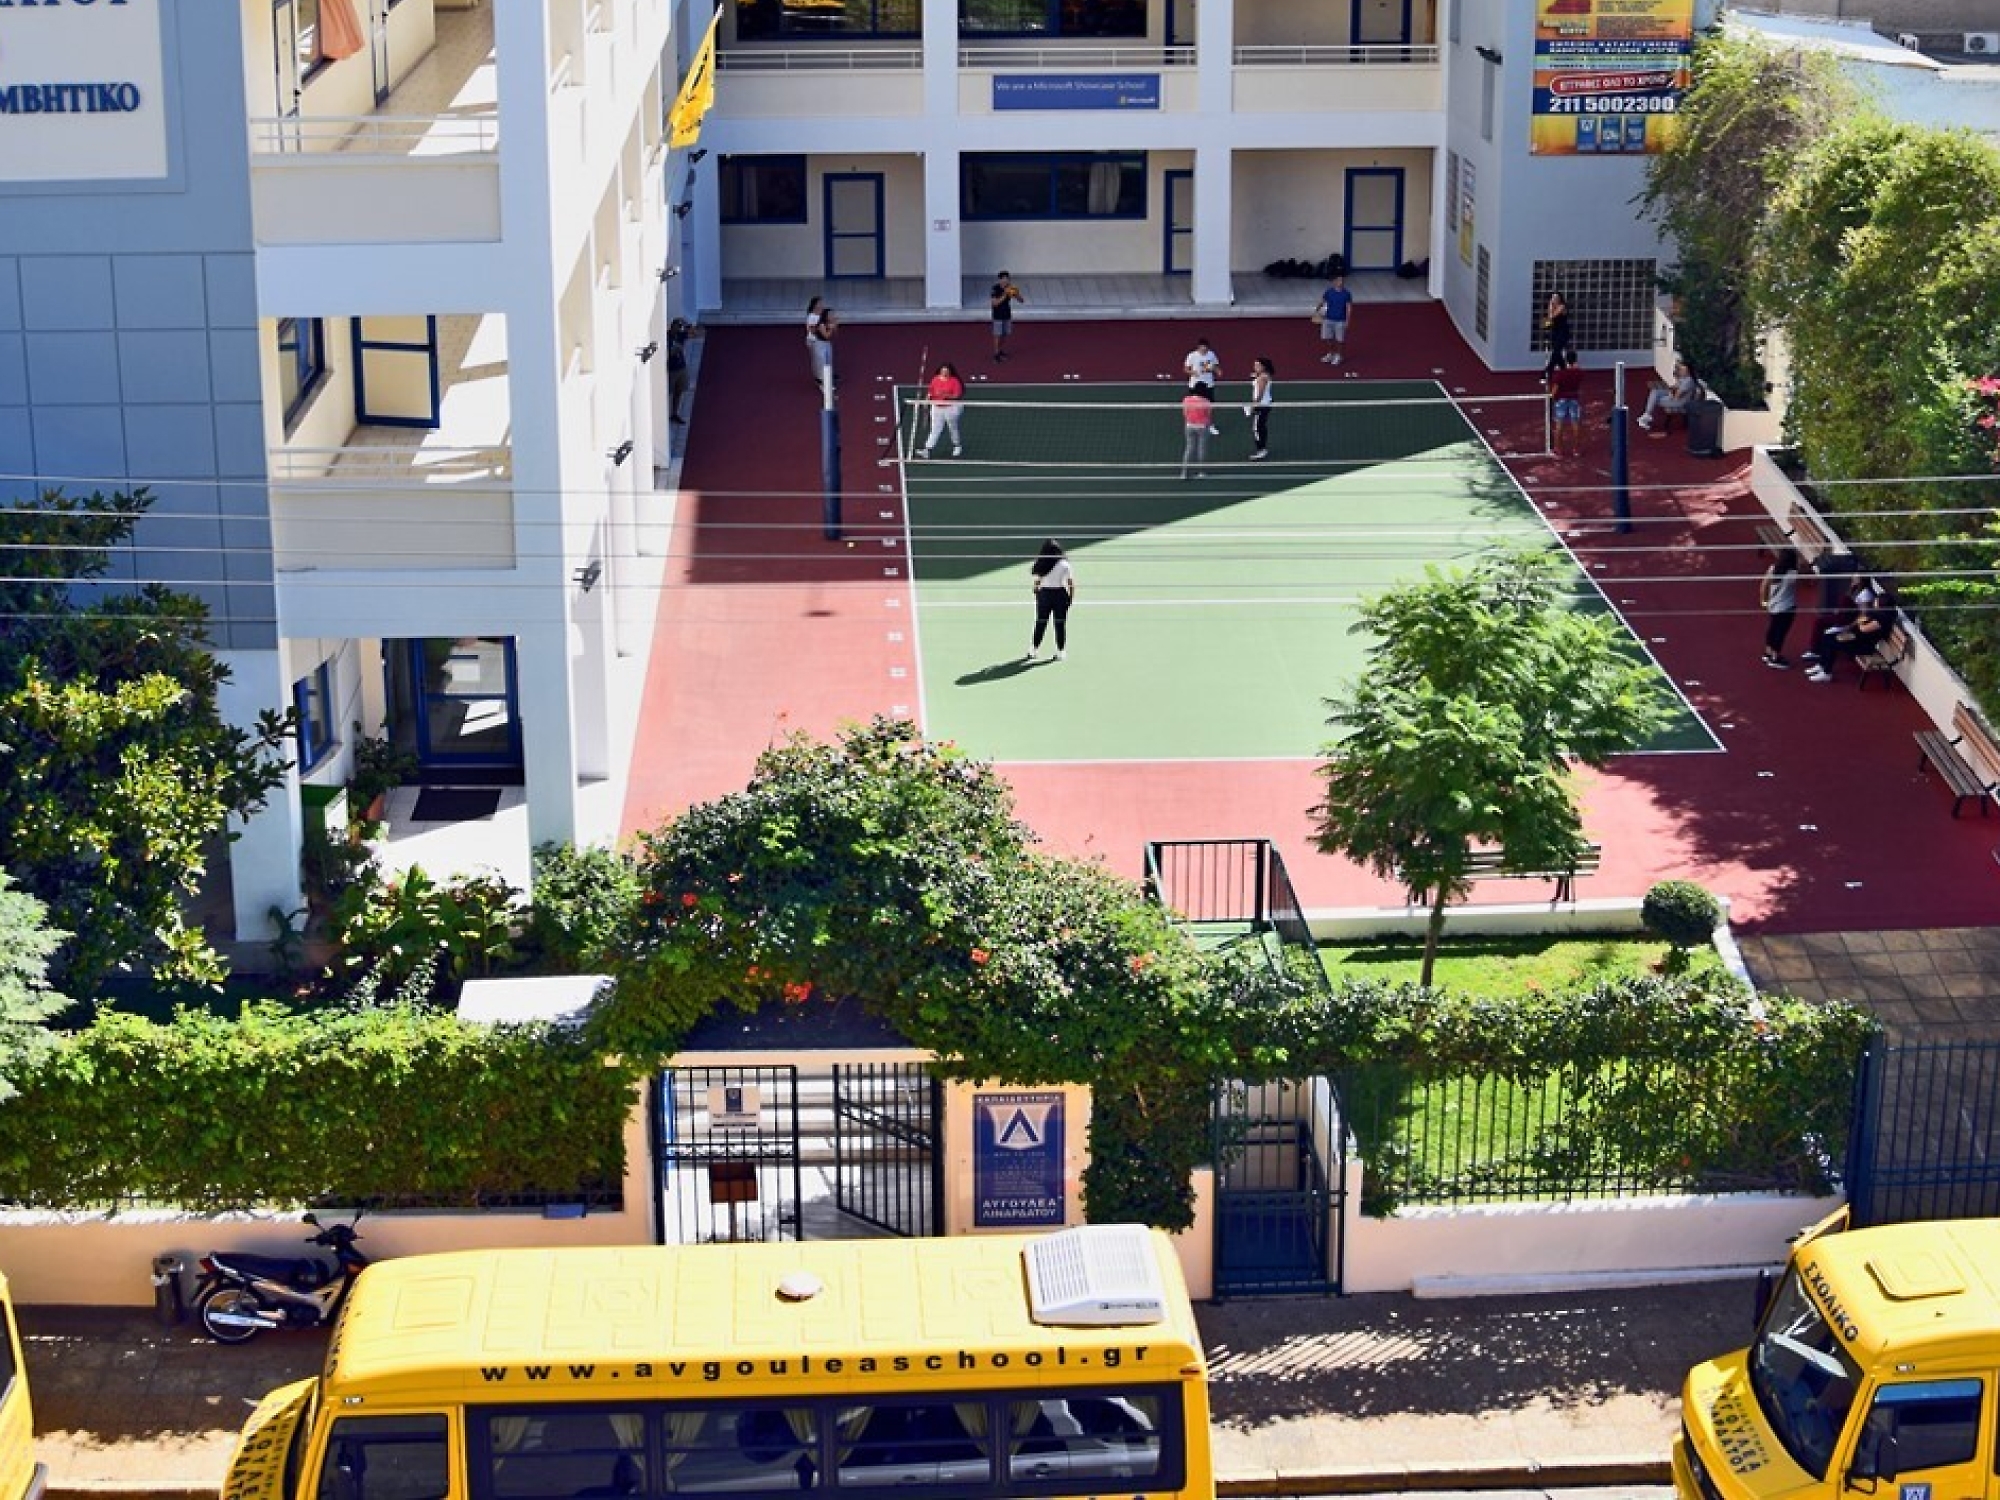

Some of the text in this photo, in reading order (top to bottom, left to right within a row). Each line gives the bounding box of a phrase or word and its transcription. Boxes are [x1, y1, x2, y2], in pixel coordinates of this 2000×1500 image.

[1033, 81, 1073, 90] Microsoft
[1074, 81, 1115, 90] Showcase
[1117, 81, 1147, 90] School
[1549, 96, 1674, 112] 211 5002300
[481, 1346, 1148, 1382] www.avgouleaschool.gr
[1711, 1385, 1761, 1470] ΥΓΟΥΛΕΑ
